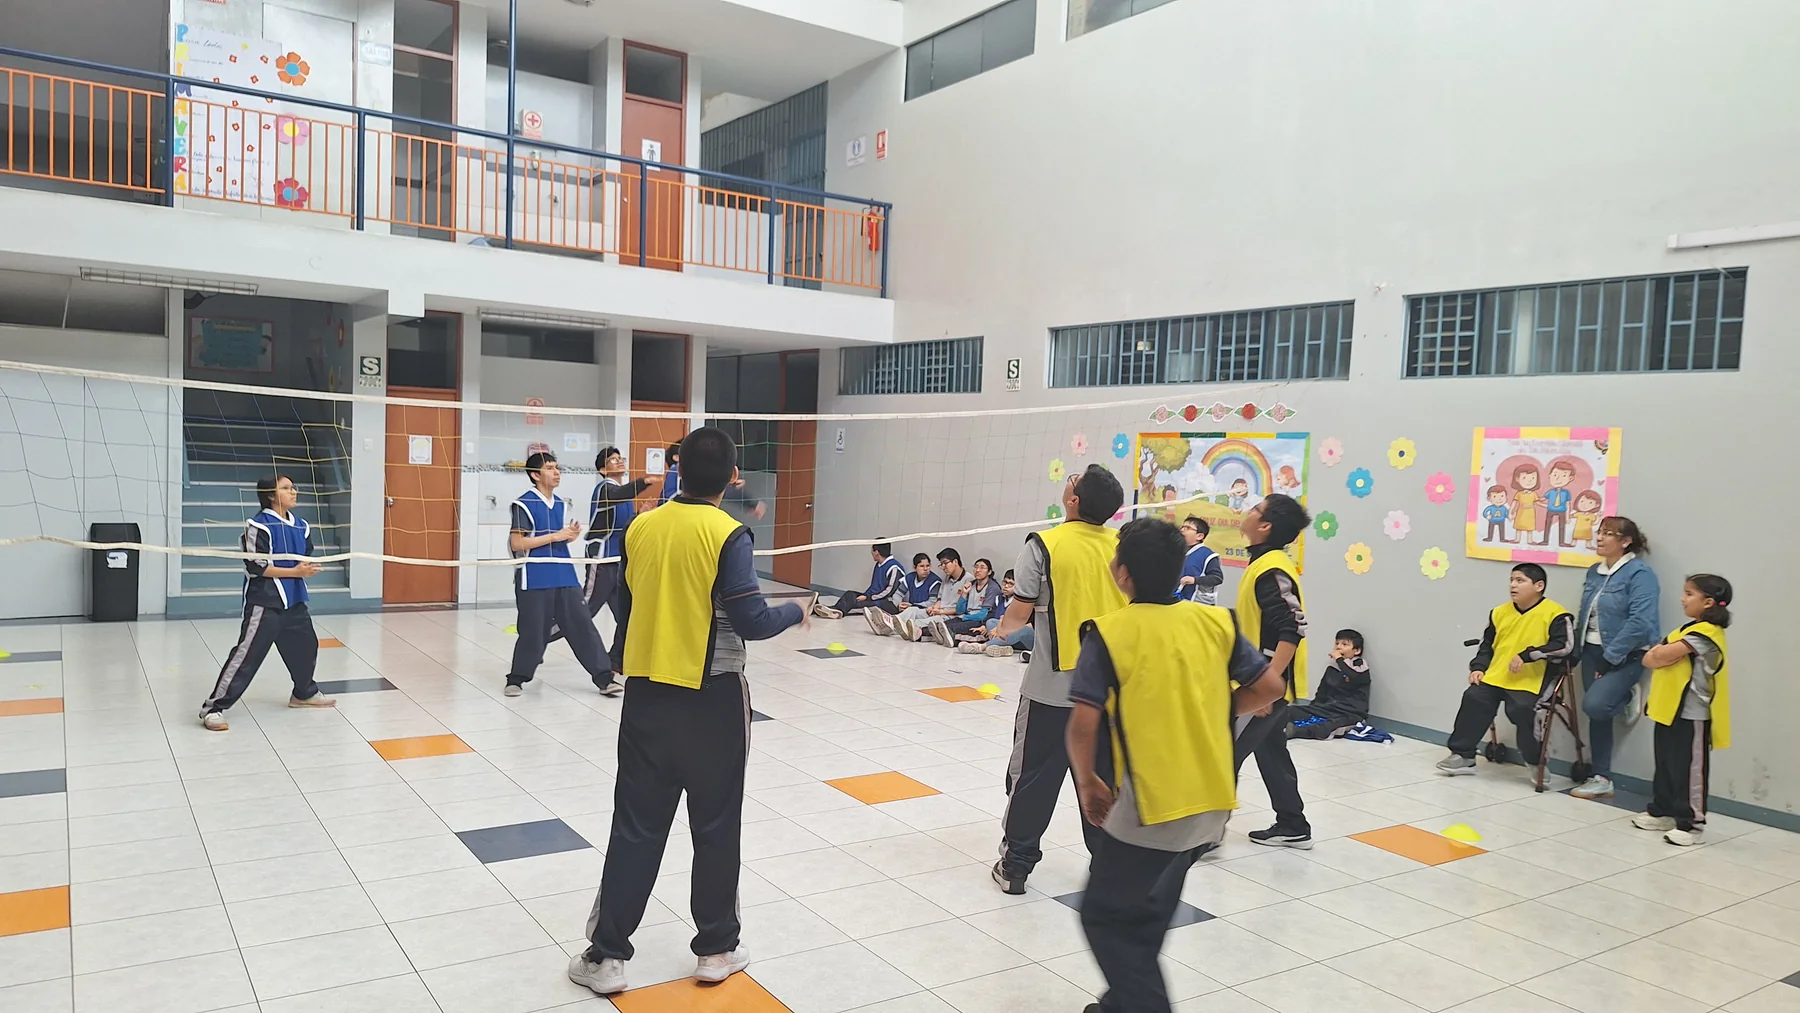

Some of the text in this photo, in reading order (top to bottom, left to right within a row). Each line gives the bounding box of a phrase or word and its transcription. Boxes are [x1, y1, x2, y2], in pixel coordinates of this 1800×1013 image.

[362, 357, 379, 375] S
[1009, 360, 1018, 378] S
[1225, 548, 1233, 556] 23
